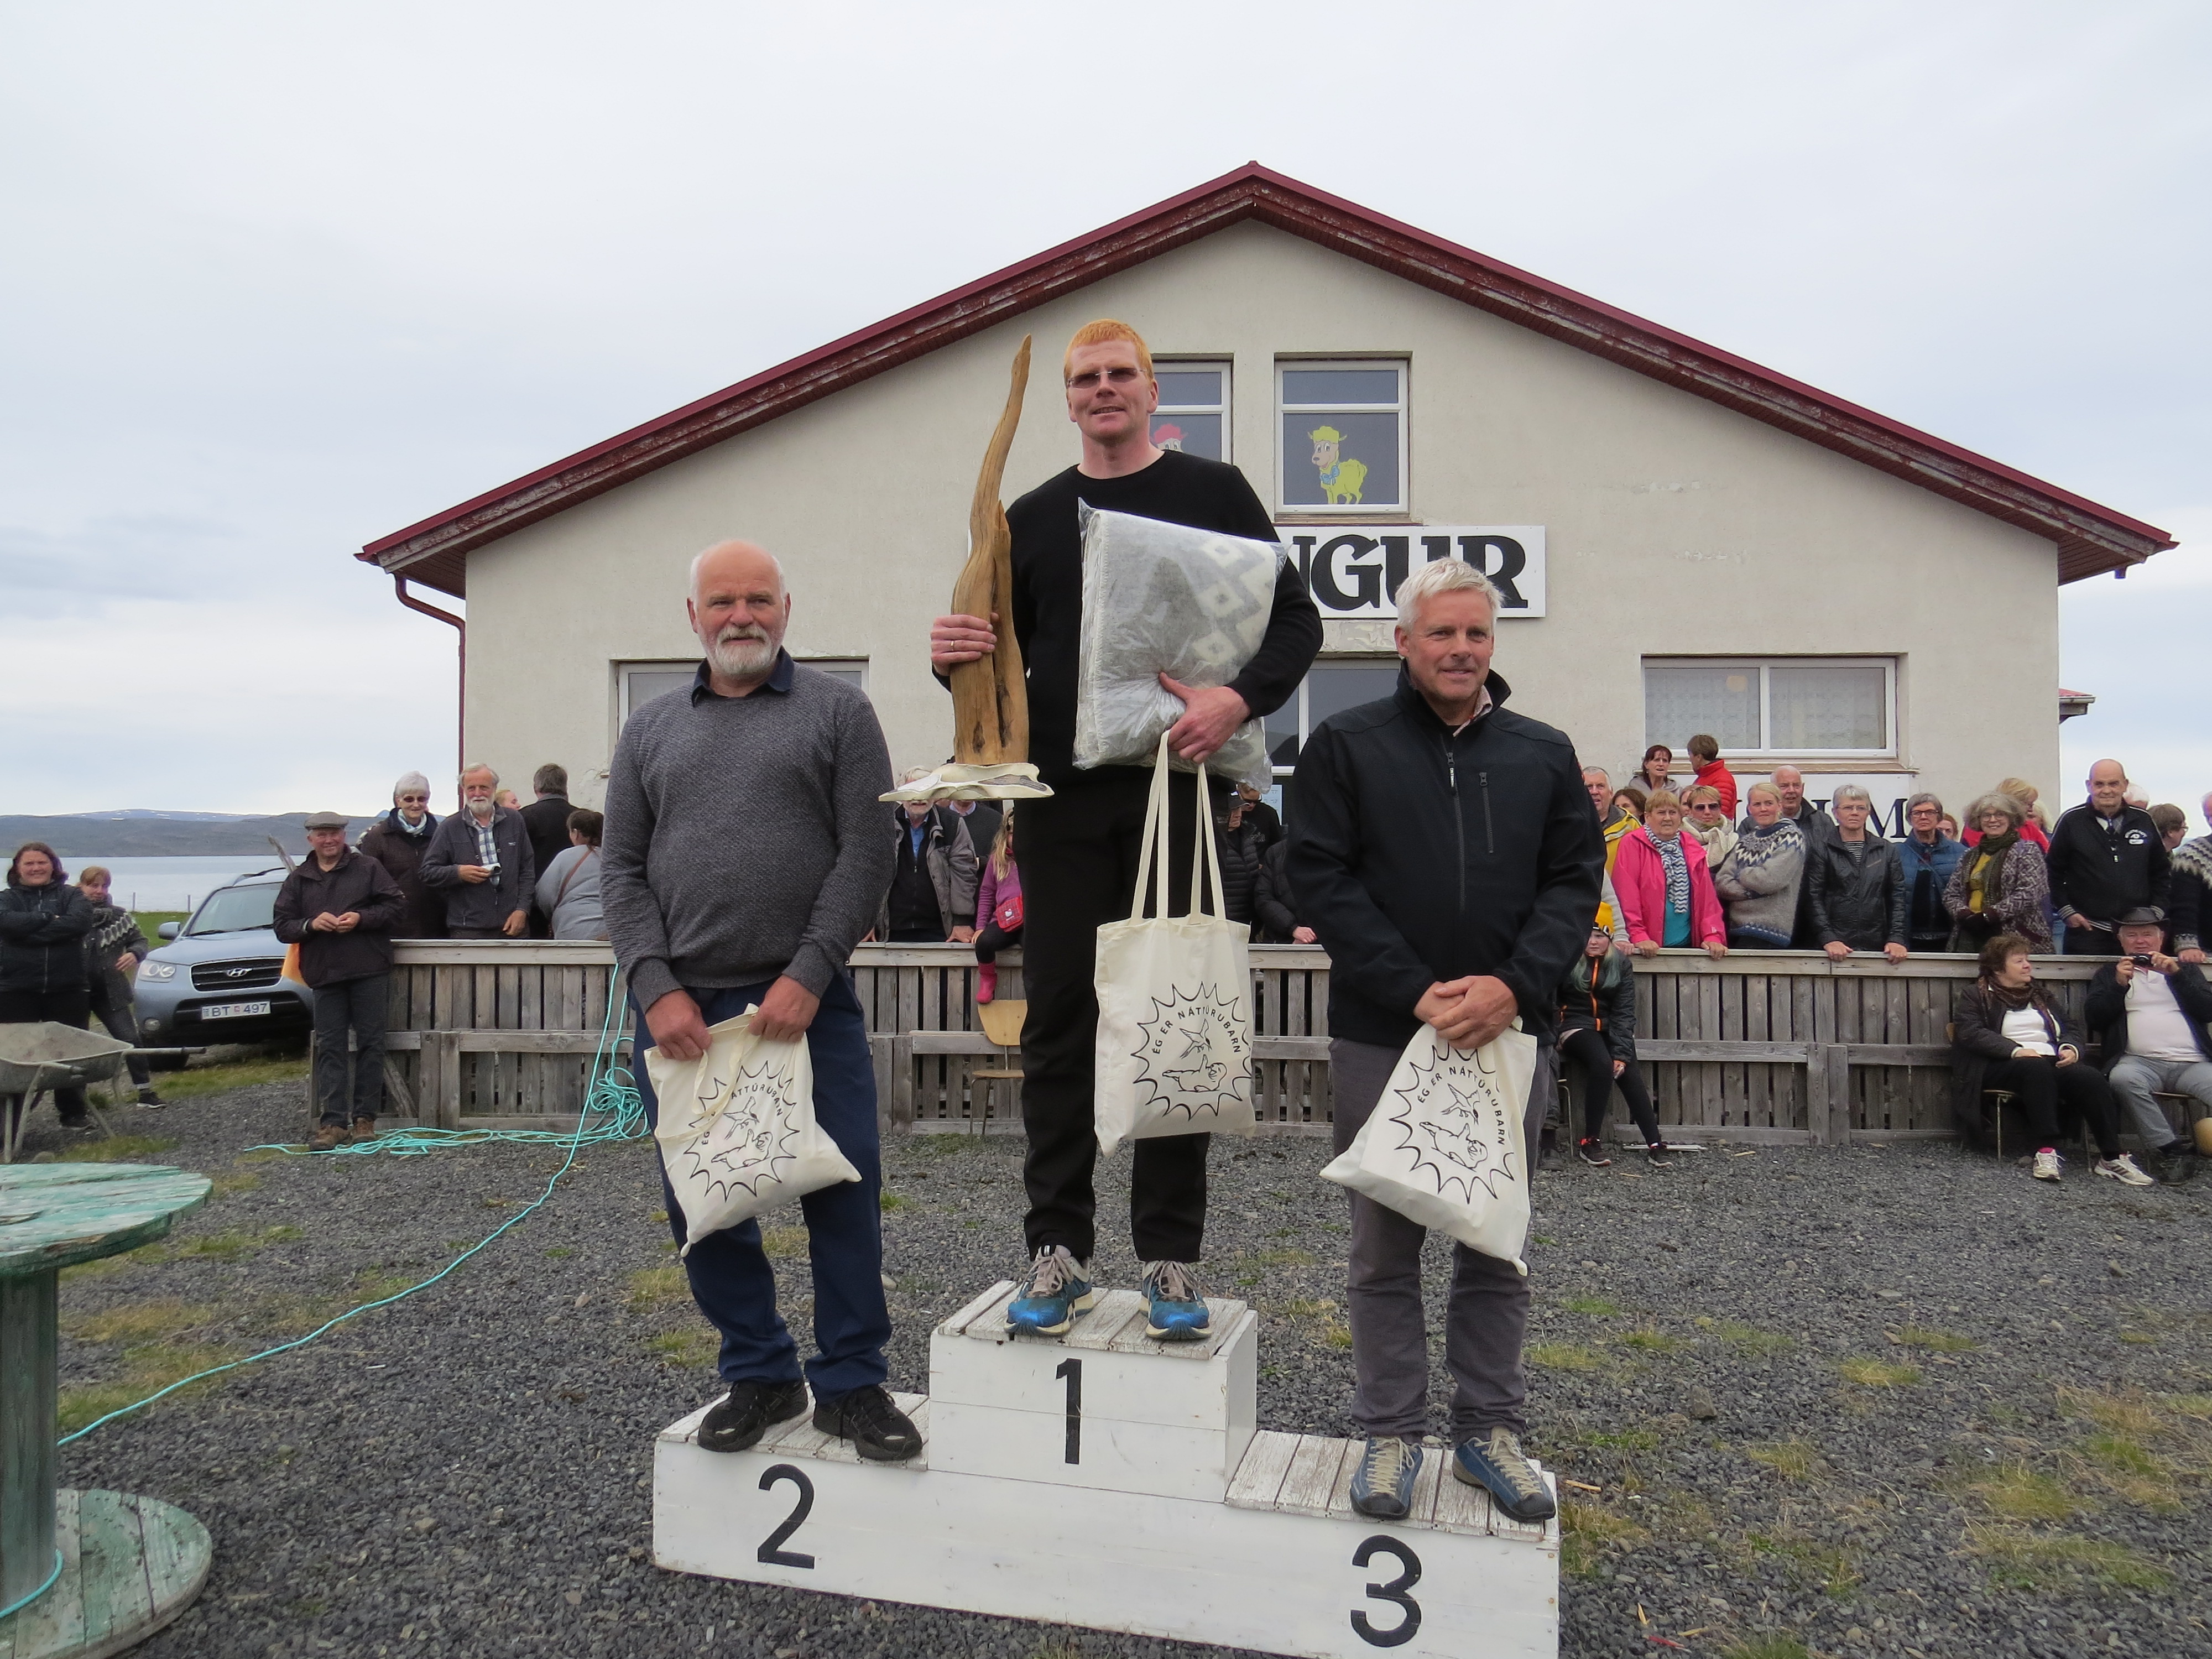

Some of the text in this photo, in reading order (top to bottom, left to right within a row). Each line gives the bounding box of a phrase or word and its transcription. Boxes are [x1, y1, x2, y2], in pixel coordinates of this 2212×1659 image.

[212, 1003, 267, 1017] BT 497
[1151, 1039, 1163, 1054] ÉG
[1160, 1020, 1173, 1035] ER
[1417, 1066, 1506, 1145] ÉG ER NÁTTÚRUBARN
[1056, 1358, 1082, 1465] 1
[757, 1463, 815, 1570] 2
[1350, 1535, 1422, 1647] 3
